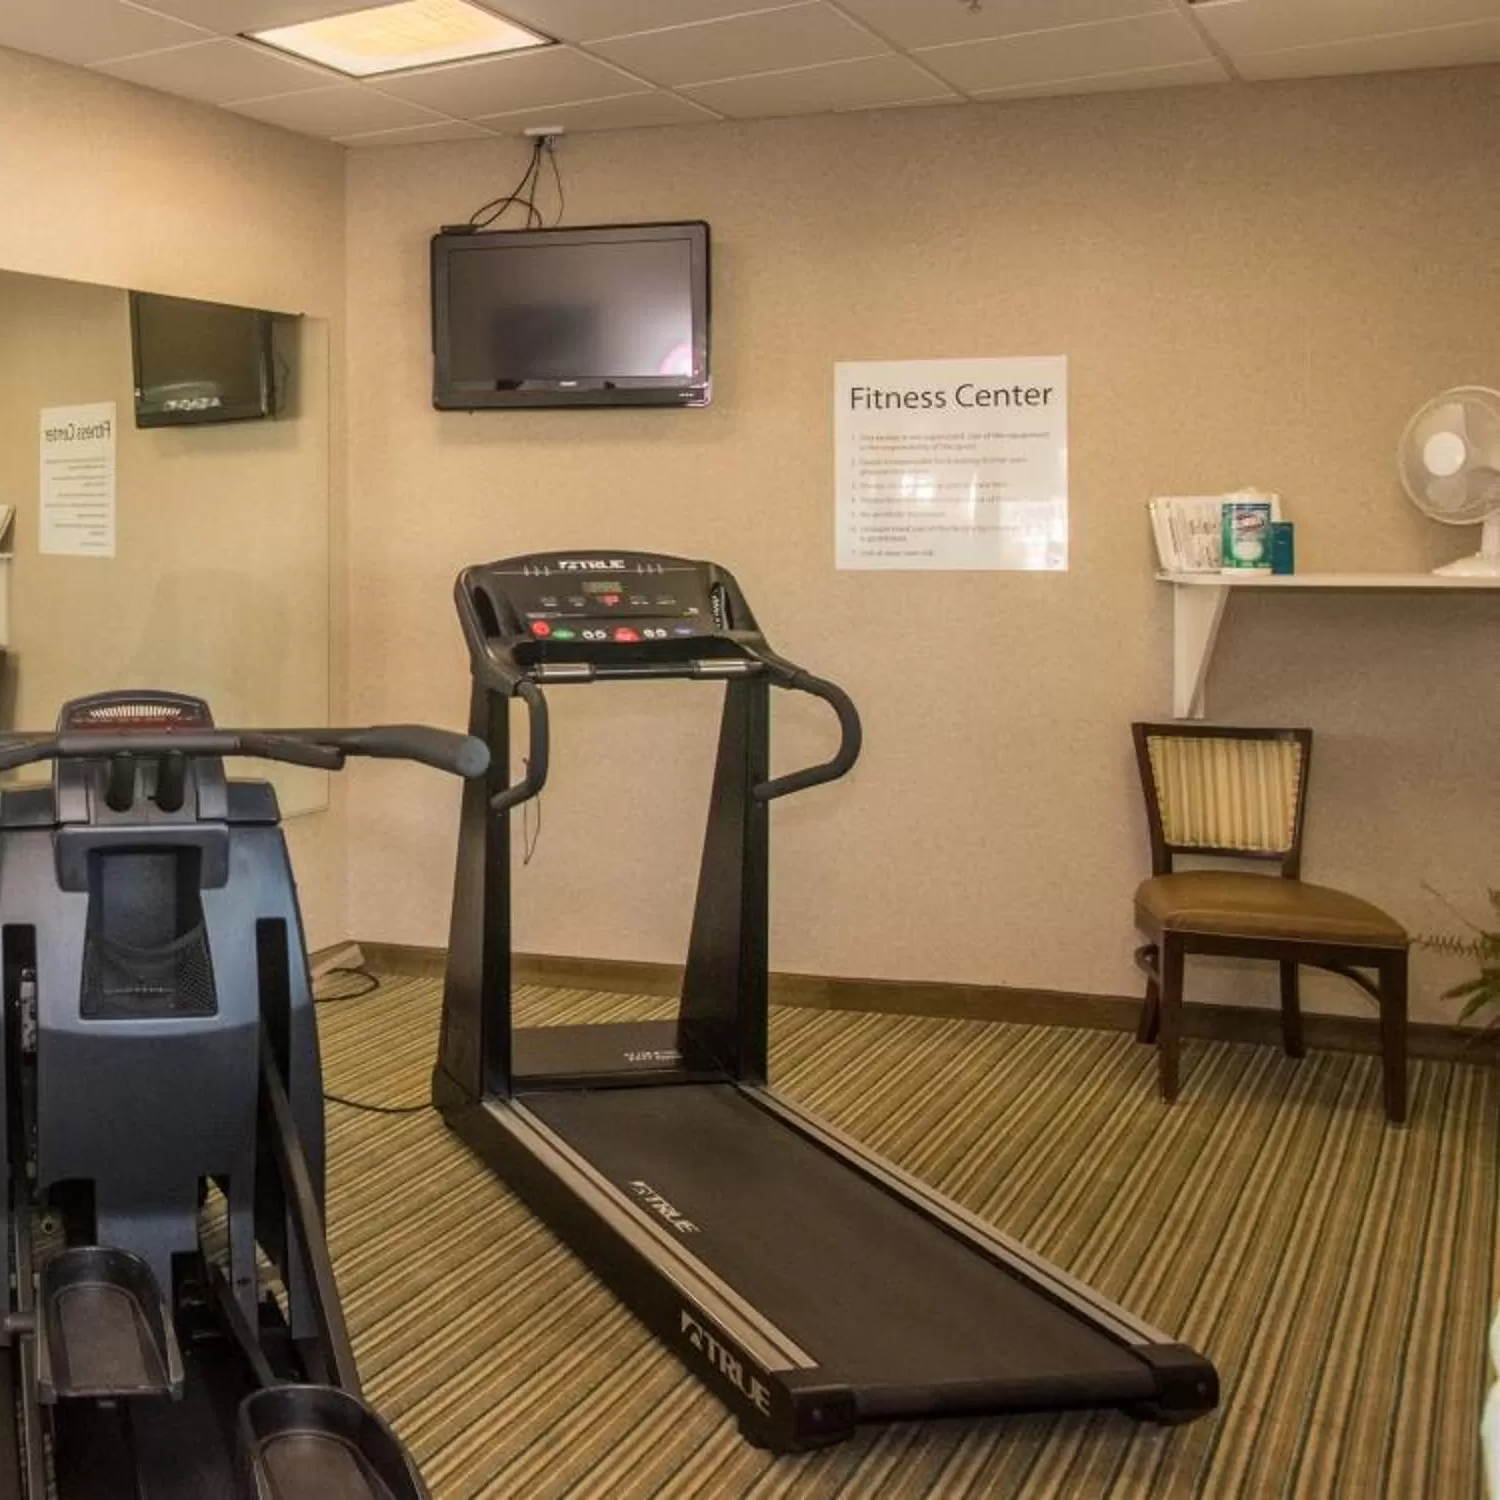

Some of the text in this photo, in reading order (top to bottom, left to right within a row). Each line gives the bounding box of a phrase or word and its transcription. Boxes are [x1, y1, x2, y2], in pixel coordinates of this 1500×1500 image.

[850, 383, 1053, 410] Fitness Center
[702, 1332, 771, 1418] TRUE
